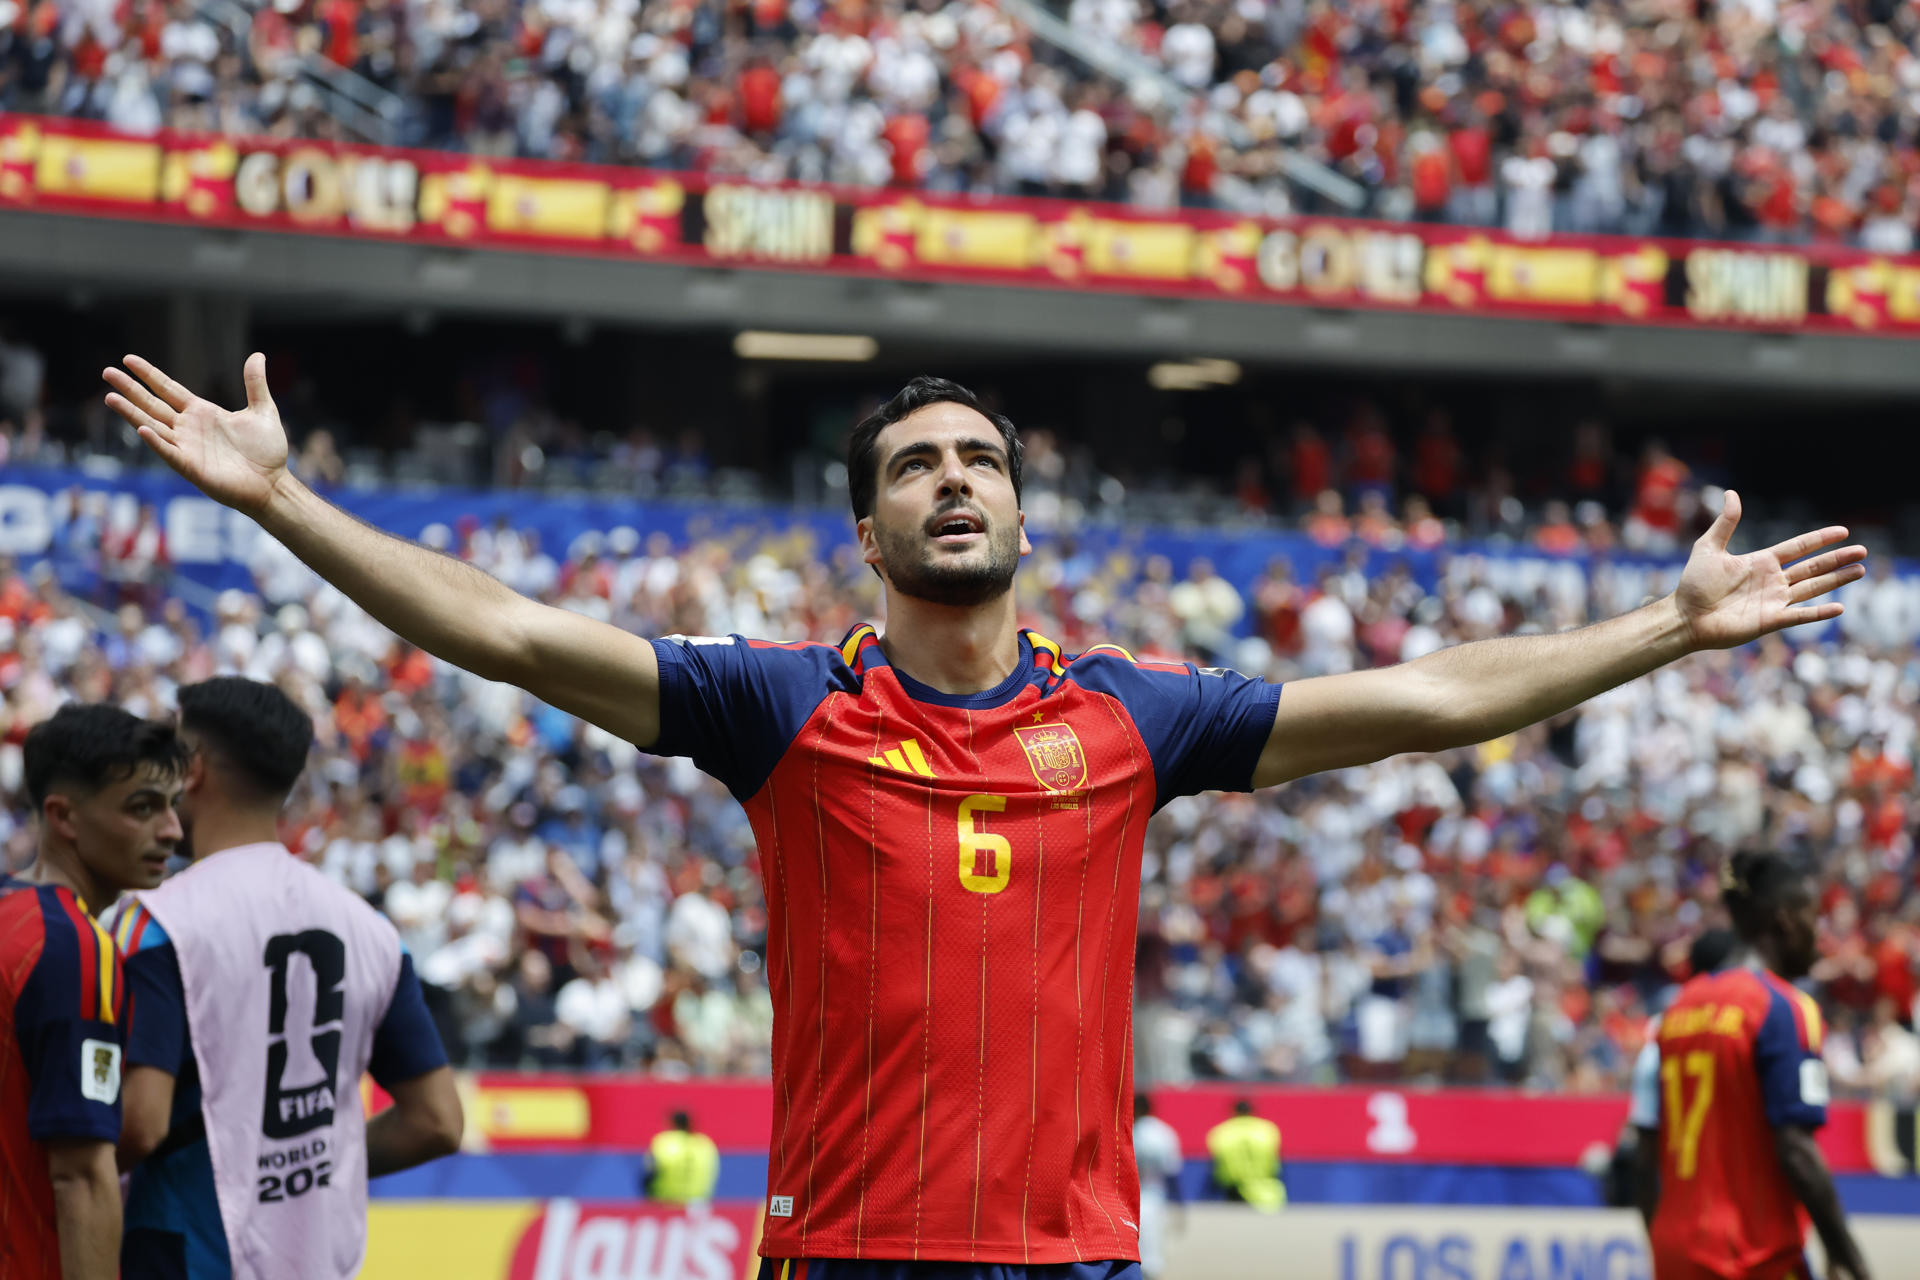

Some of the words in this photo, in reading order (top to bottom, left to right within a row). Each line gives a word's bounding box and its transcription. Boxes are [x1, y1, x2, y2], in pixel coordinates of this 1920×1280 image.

[957, 794, 1012, 894] 6
[279, 1086, 336, 1122] FIFA
[1661, 1050, 1716, 1181] 17
[258, 1139, 327, 1169] WORLD
